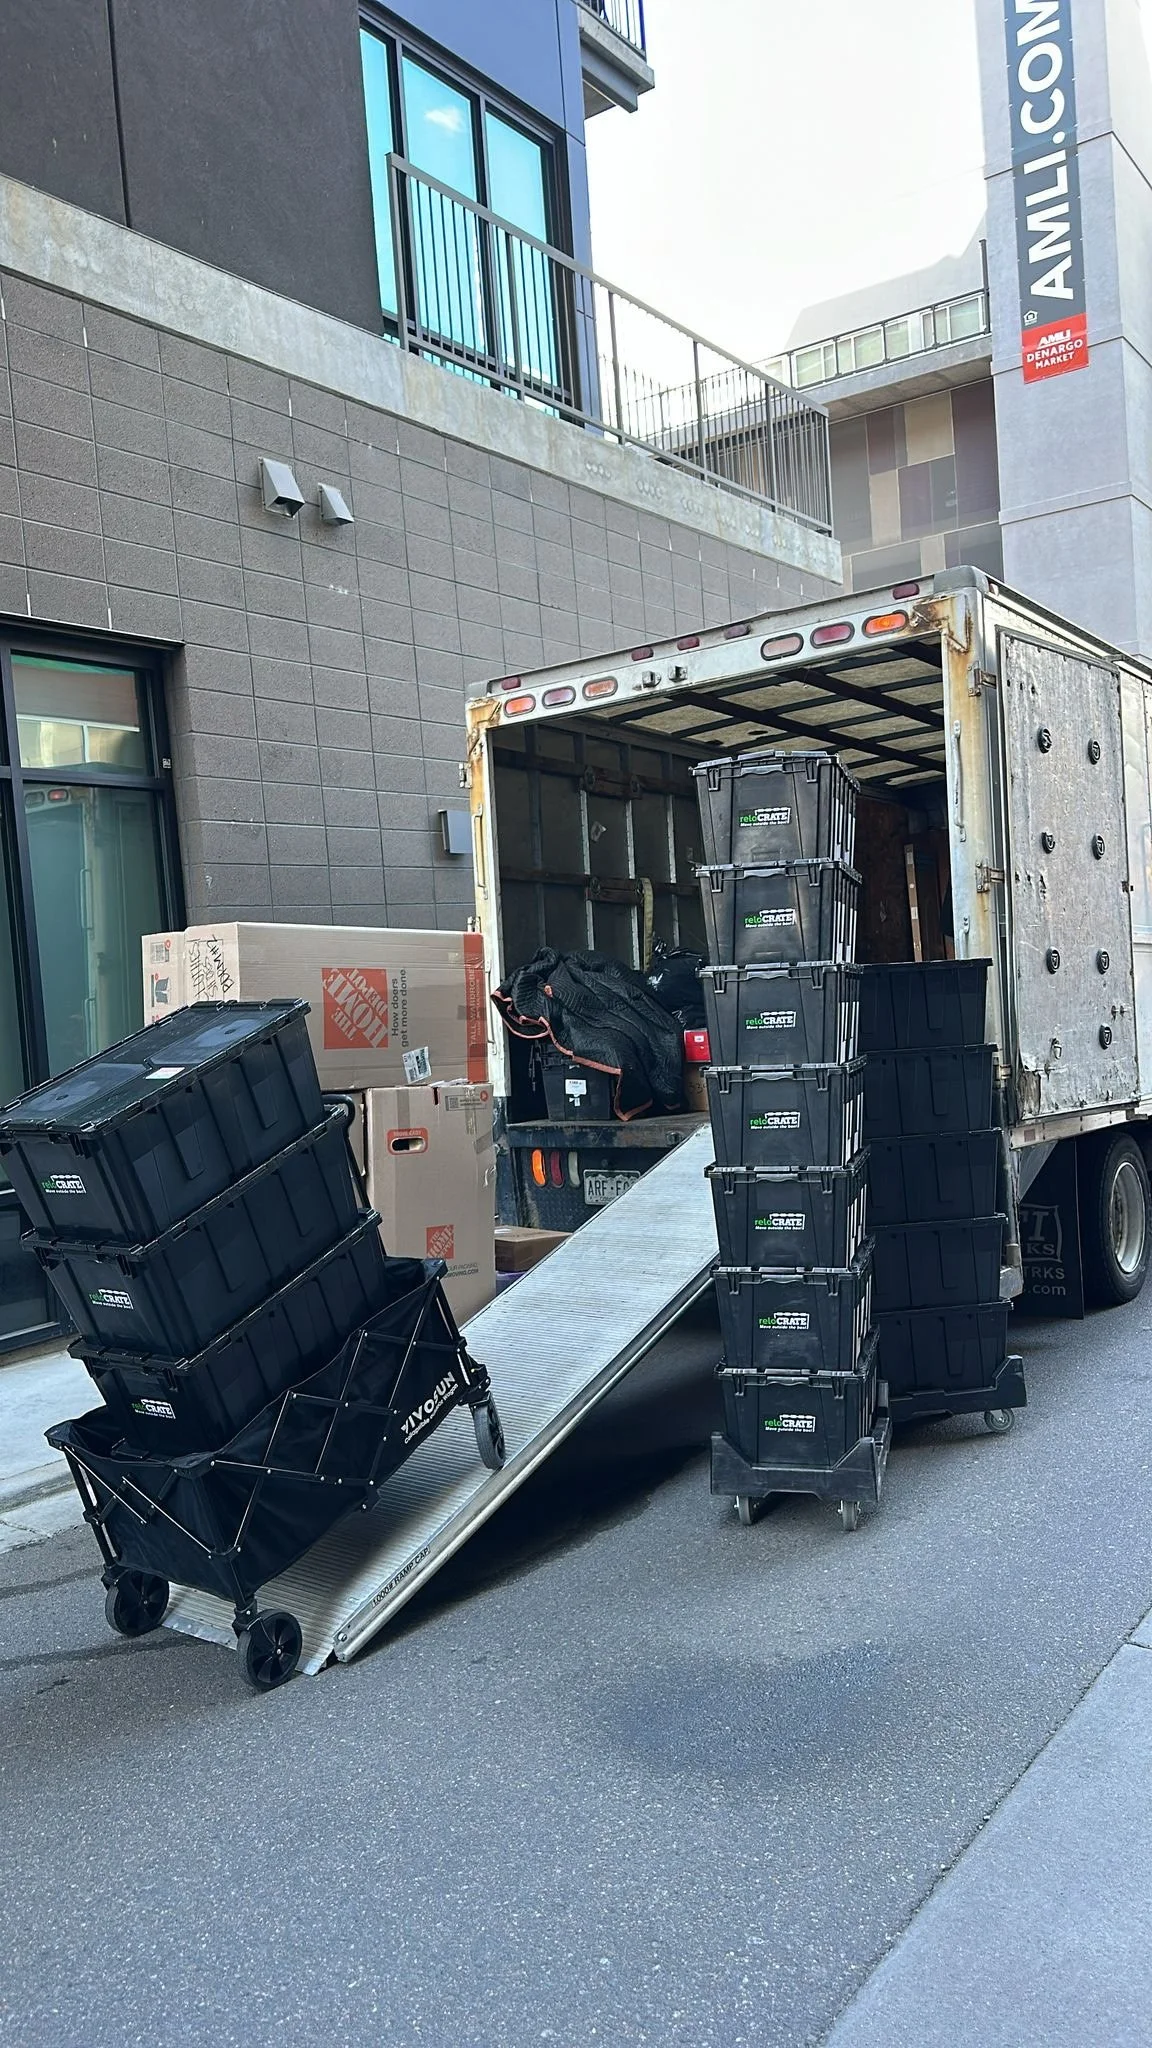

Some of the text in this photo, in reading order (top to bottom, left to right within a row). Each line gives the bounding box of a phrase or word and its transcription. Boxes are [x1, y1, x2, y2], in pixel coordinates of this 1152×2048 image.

[1014, 0, 1074, 300] AMLI.COM
[1038, 329, 1071, 347] AMLI
[1026, 339, 1083, 363] DENARGO
[1035, 352, 1075, 369] MARKET
[739, 812, 788, 823] reloCRATE
[744, 914, 793, 924] reloCRATE
[346, 968, 388, 1017] DEPOT
[322, 968, 388, 1049] HOME
[391, 978, 399, 1036] How doers
[468, 966, 478, 1047] TALL WARDROBE
[331, 1006, 357, 1041] THE
[745, 1015, 794, 1026] reloCRATE
[401, 1030, 409, 1048] get
[750, 1116, 798, 1126] reloCRATE
[588, 1179, 609, 1196] ARF
[754, 1218, 803, 1226] reloCRATE
[759, 1317, 807, 1326] reloCRATE
[400, 1371, 456, 1434] VIVOSUN
[764, 1419, 813, 1429] reloCRATE
[394, 1561, 414, 1586] RAMP
[414, 1546, 430, 1564] CAP
